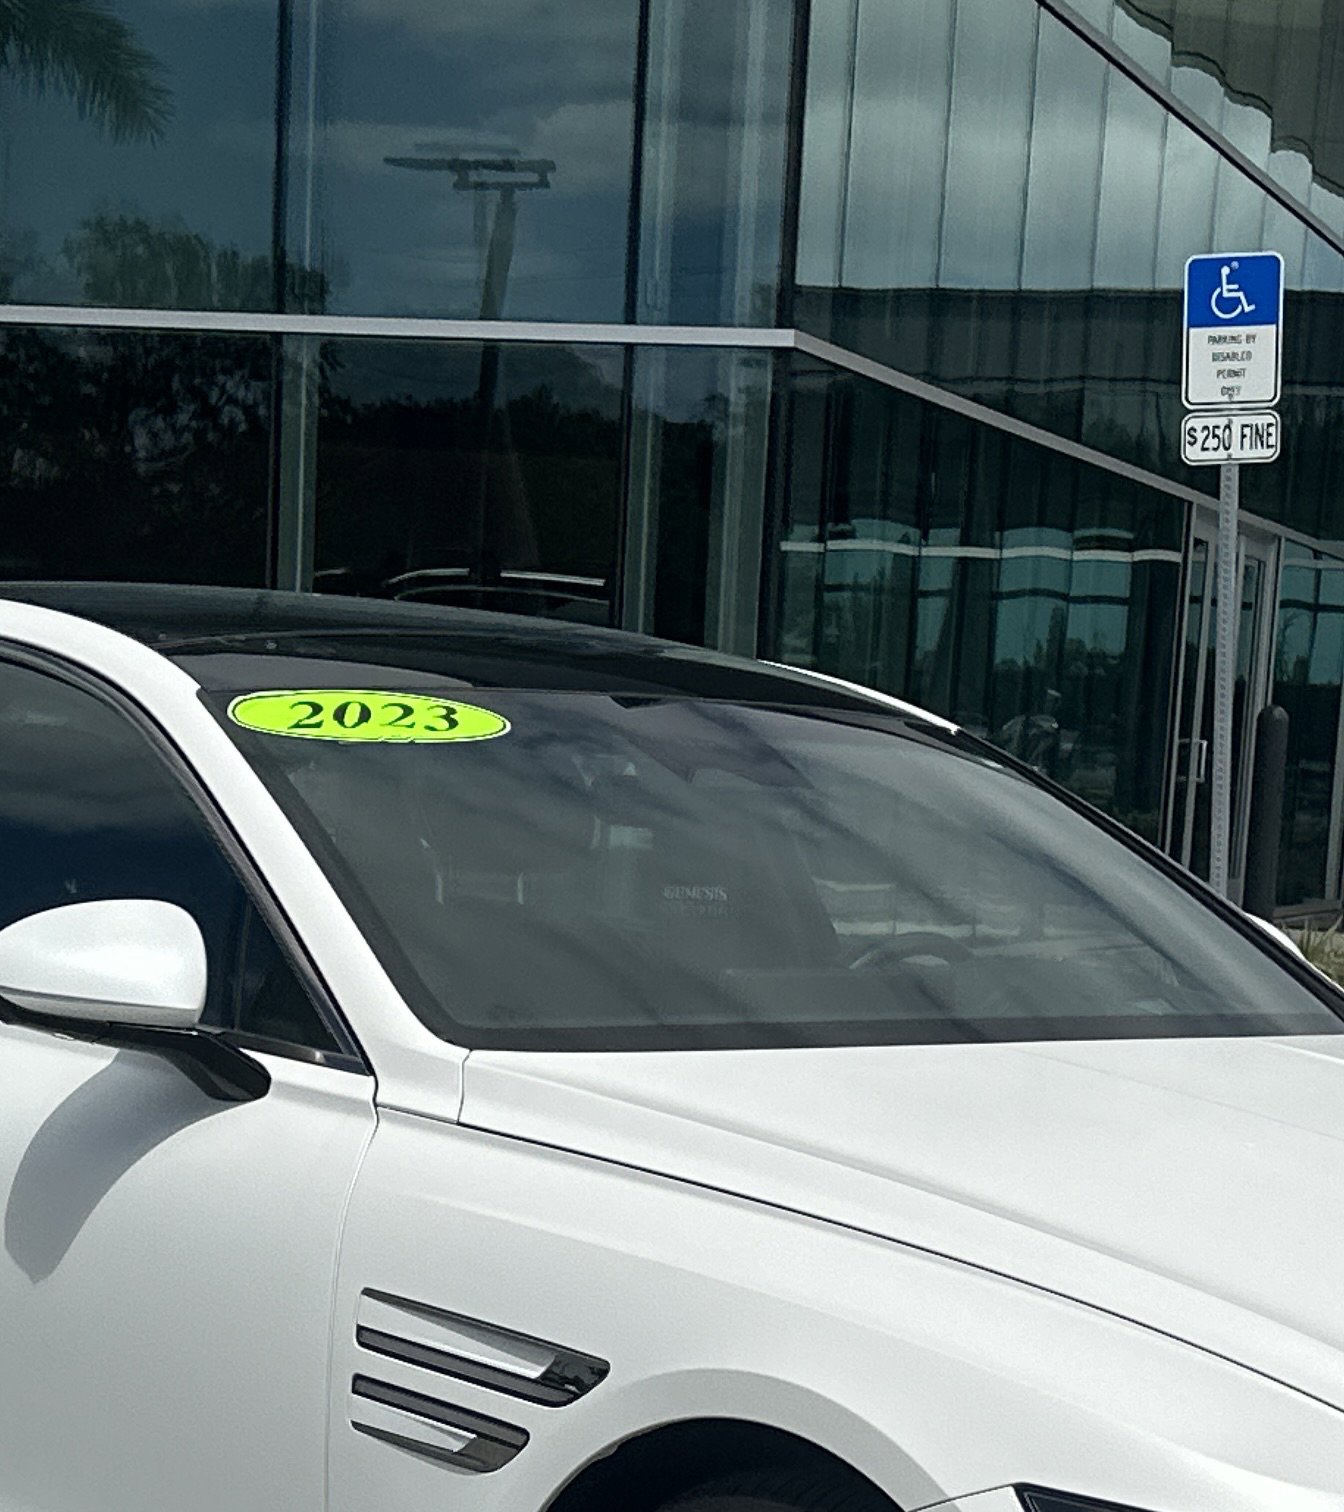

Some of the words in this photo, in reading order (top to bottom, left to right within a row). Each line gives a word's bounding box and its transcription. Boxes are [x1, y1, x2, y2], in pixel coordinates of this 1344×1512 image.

[1187, 423, 1233, 451] $250
[1240, 423, 1275, 450] FINE
[287, 700, 459, 732] 2023
